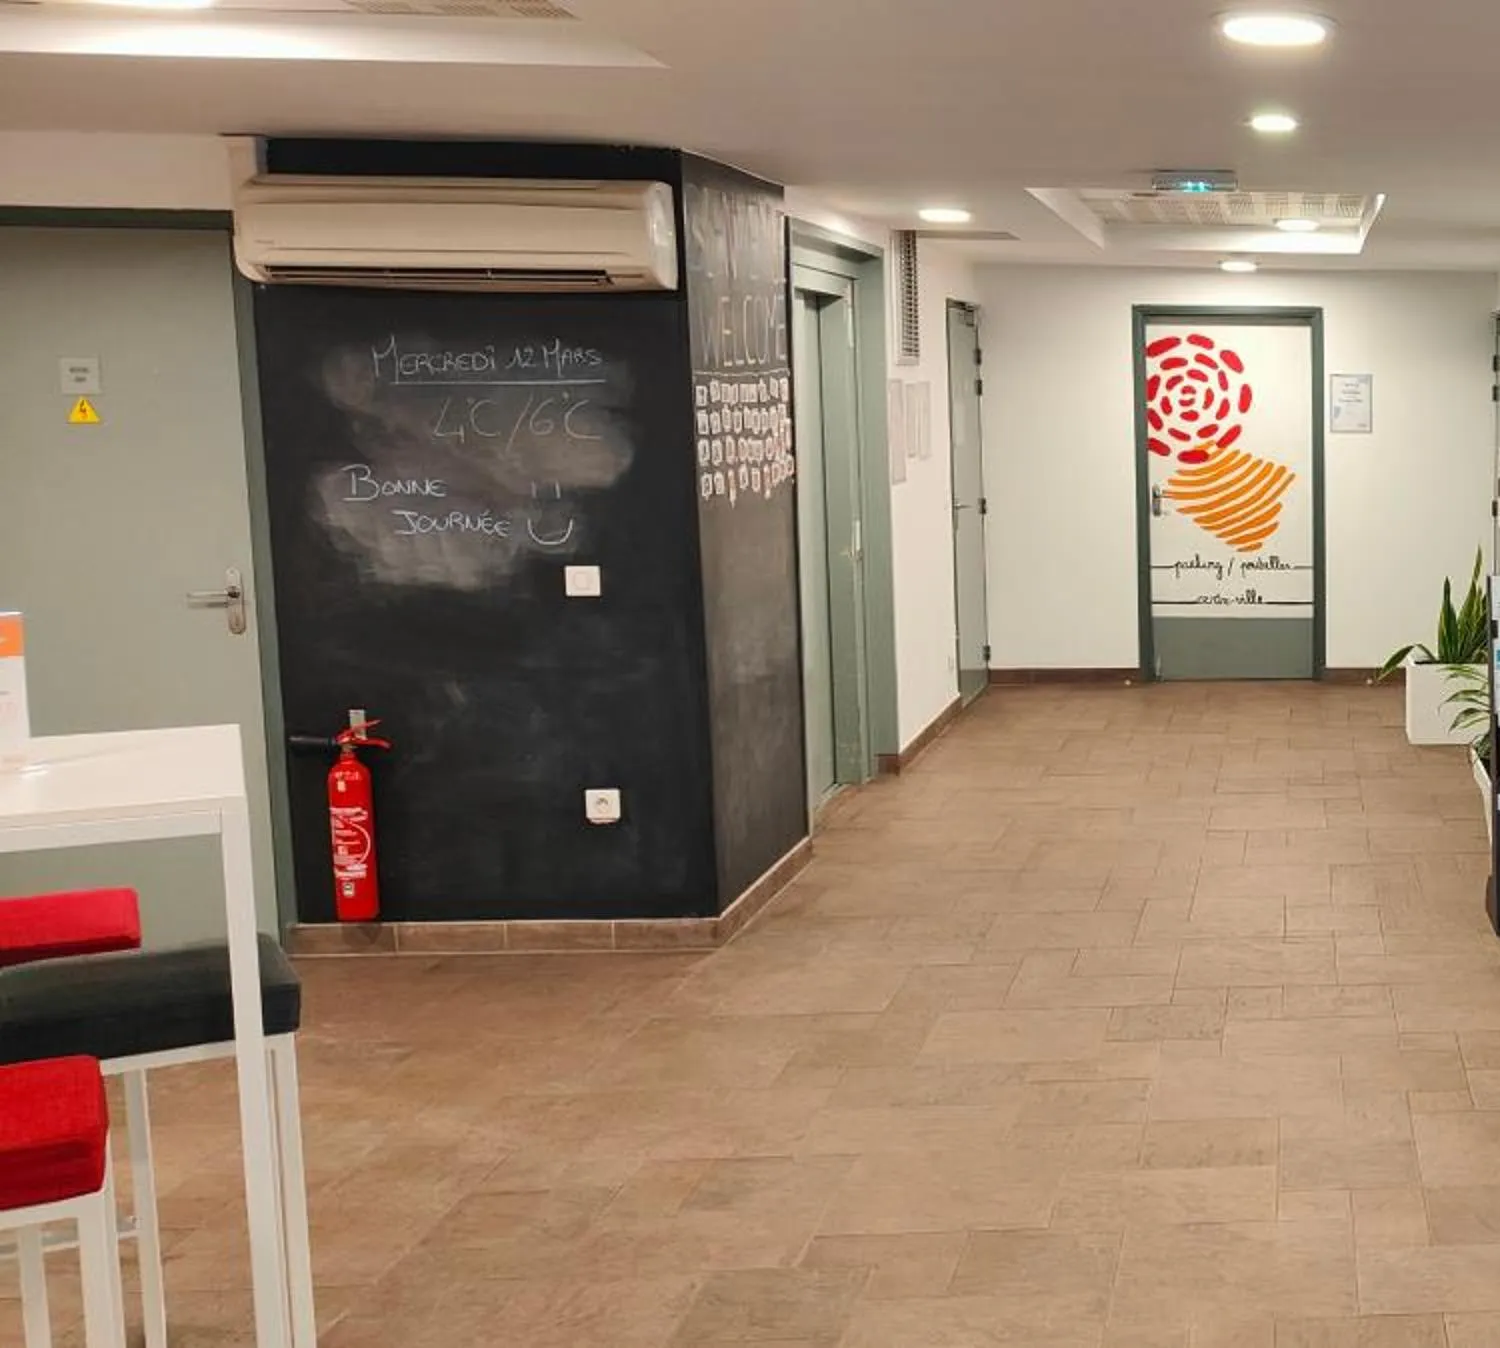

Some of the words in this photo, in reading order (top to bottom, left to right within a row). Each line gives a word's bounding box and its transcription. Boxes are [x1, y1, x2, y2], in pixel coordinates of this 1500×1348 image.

[505, 347, 534, 369] 12
[341, 463, 448, 501] BONNE
[391, 510, 512, 538] JOURNÉE
